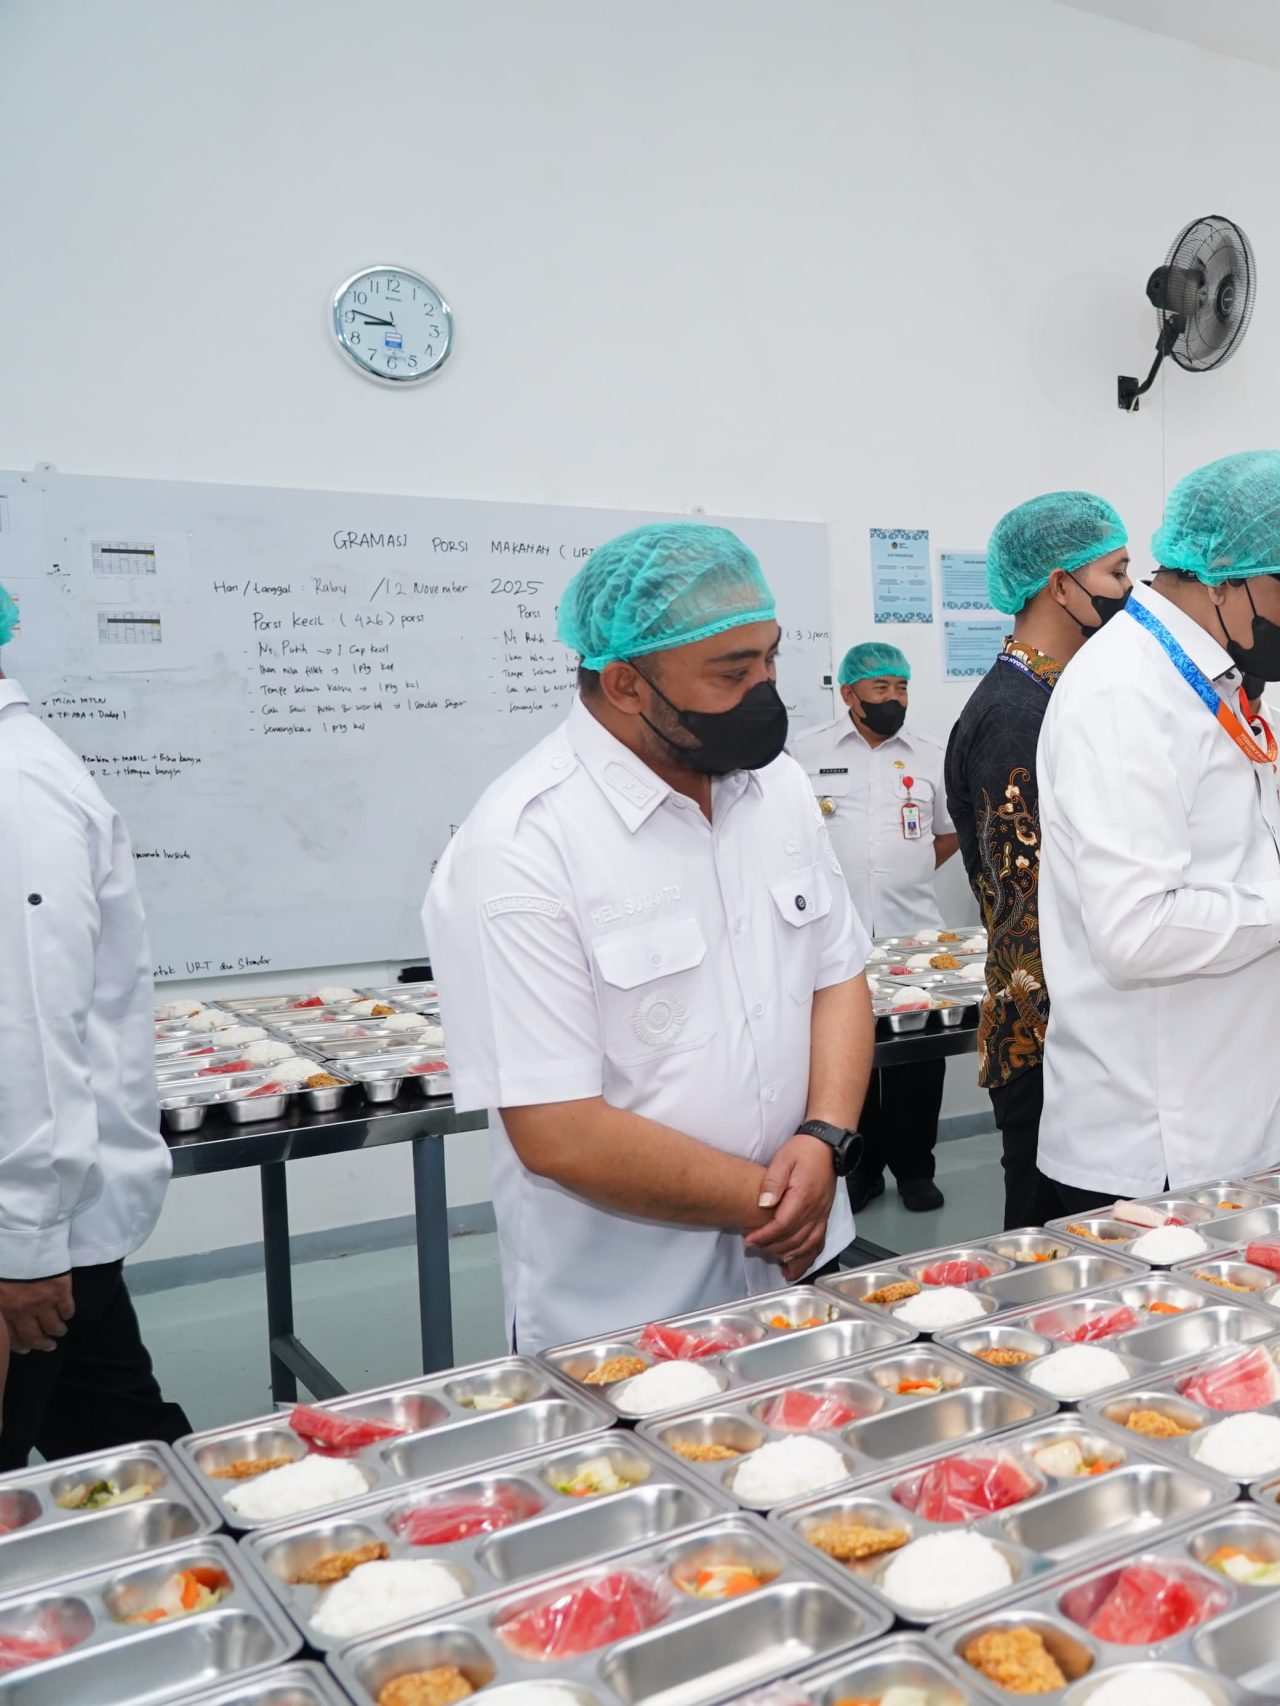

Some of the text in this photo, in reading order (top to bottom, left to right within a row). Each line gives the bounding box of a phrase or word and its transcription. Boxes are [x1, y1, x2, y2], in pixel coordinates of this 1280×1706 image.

[370, 280, 379, 293] 11
[387, 279, 401, 293] 12
[353, 290, 368, 305] 10
[344, 310, 356, 323] 9
[423, 303, 434, 317] 2
[350, 331, 361, 344] 8
[428, 325, 440, 339] 3
[367, 348, 377, 361] 7
[424, 344, 433, 357] 4
[386, 356, 397, 369] 6
[407, 355, 418, 367] 5
[333, 530, 407, 550] GRAMASI
[431, 536, 468, 553] PORSI
[413, 578, 469, 595] November
[490, 578, 544, 595] 2025
[517, 603, 541, 619] Porsi
[253, 612, 282, 631] Porsi
[153, 965, 177, 977] ntuk
